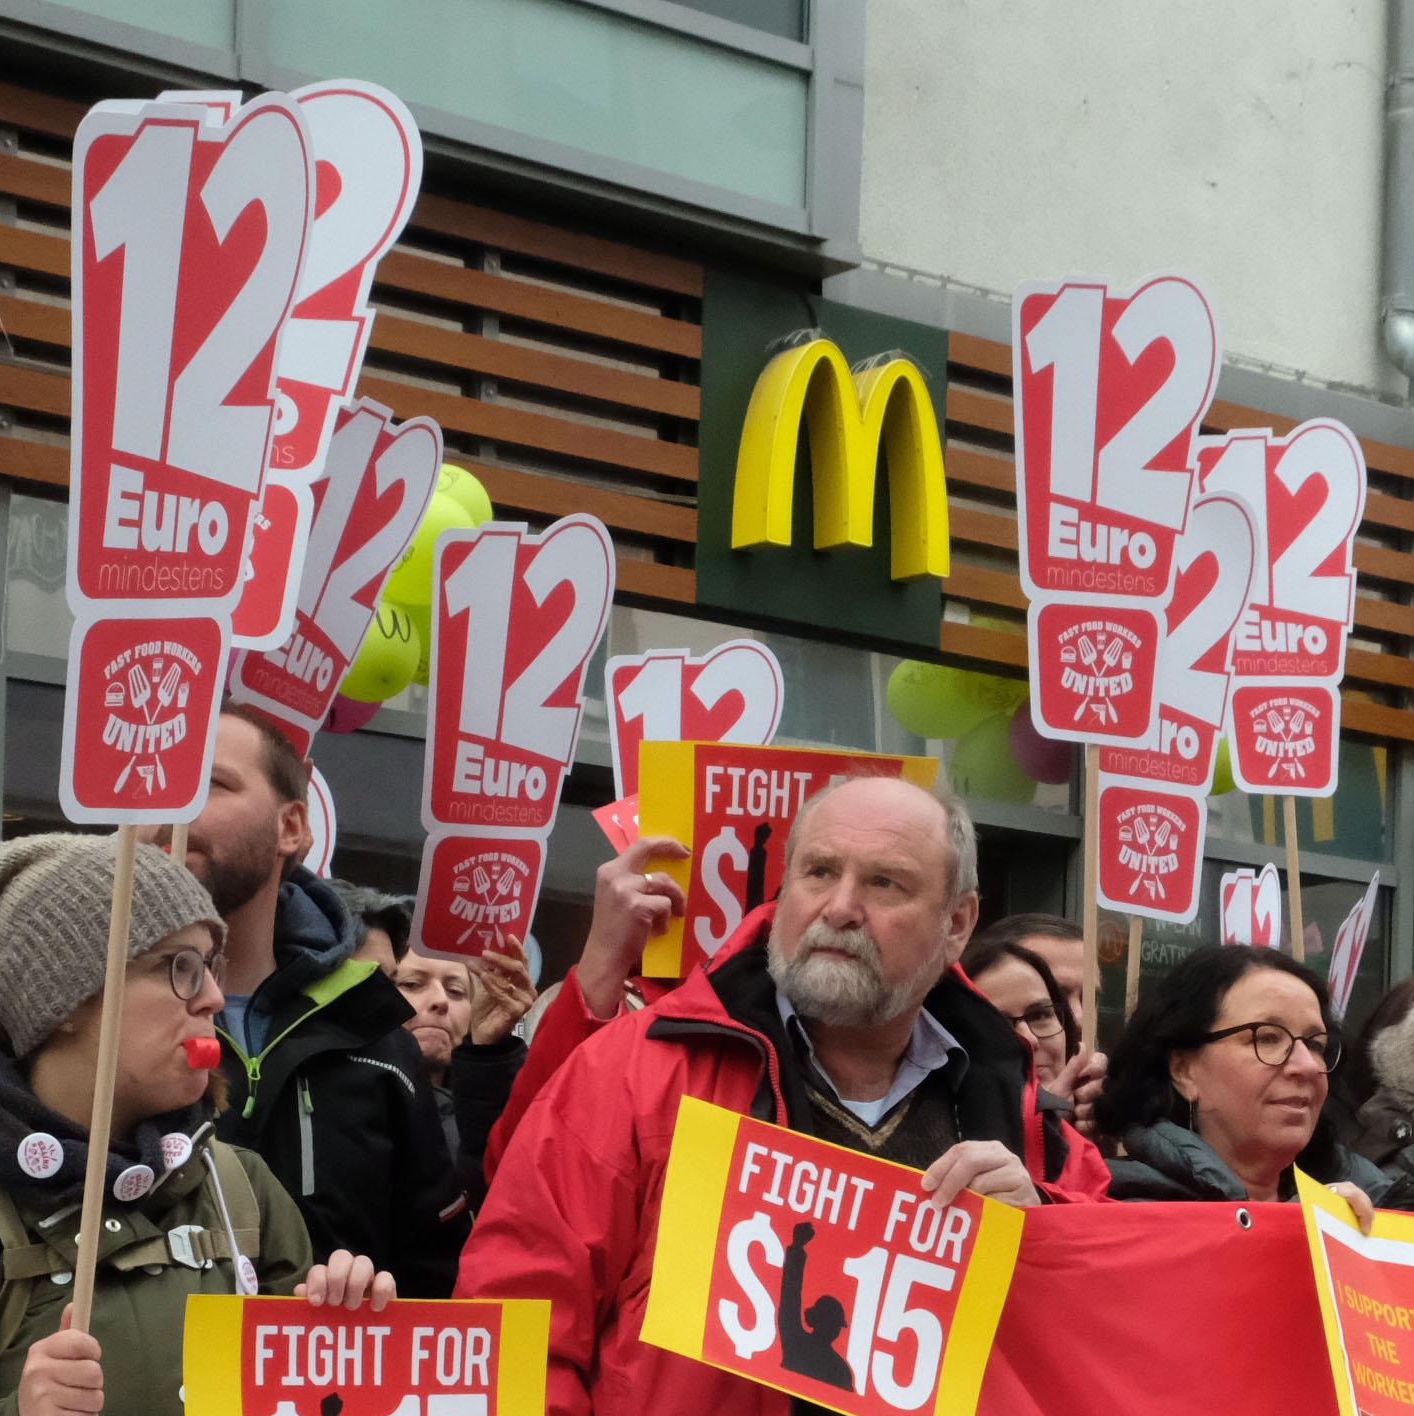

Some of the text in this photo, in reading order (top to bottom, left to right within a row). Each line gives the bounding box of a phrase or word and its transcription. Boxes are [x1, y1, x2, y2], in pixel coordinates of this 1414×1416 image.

[89, 111, 307, 493] 12
[1025, 278, 1215, 532] 12
[102, 463, 229, 556] Euro
[1203, 427, 1360, 624] 12
[297, 409, 438, 660] 12
[1047, 501, 1157, 569] Euro
[98, 560, 224, 591] mindestens
[1047, 565, 1155, 593] mindestens
[444, 523, 607, 765] 12
[1057, 620, 1142, 648] FAST FOOD WORKERS
[1235, 602, 1328, 655] Euro
[104, 641, 203, 680] FAST FOOD WORKERS
[1236, 653, 1329, 675] mindestens
[1060, 665, 1133, 698] UNITED
[1249, 702, 1269, 718] FAST
[102, 712, 187, 753] UNITED
[1255, 735, 1316, 759] UNITED
[452, 740, 547, 801] Euro
[1108, 750, 1198, 783] mindestens
[705, 766, 813, 820] FIGHT
[449, 799, 543, 824] mindestens
[1117, 806, 1136, 824] FAST
[453, 856, 476, 874] FAST
[478, 852, 499, 862] FOOD
[1118, 844, 1179, 874] UNITED
[449, 894, 521, 924] UNITED
[737, 1140, 973, 1264] FIGHT FOR
[255, 1325, 491, 1387] FIGHT FOR
[1366, 1332, 1401, 1365] THE
